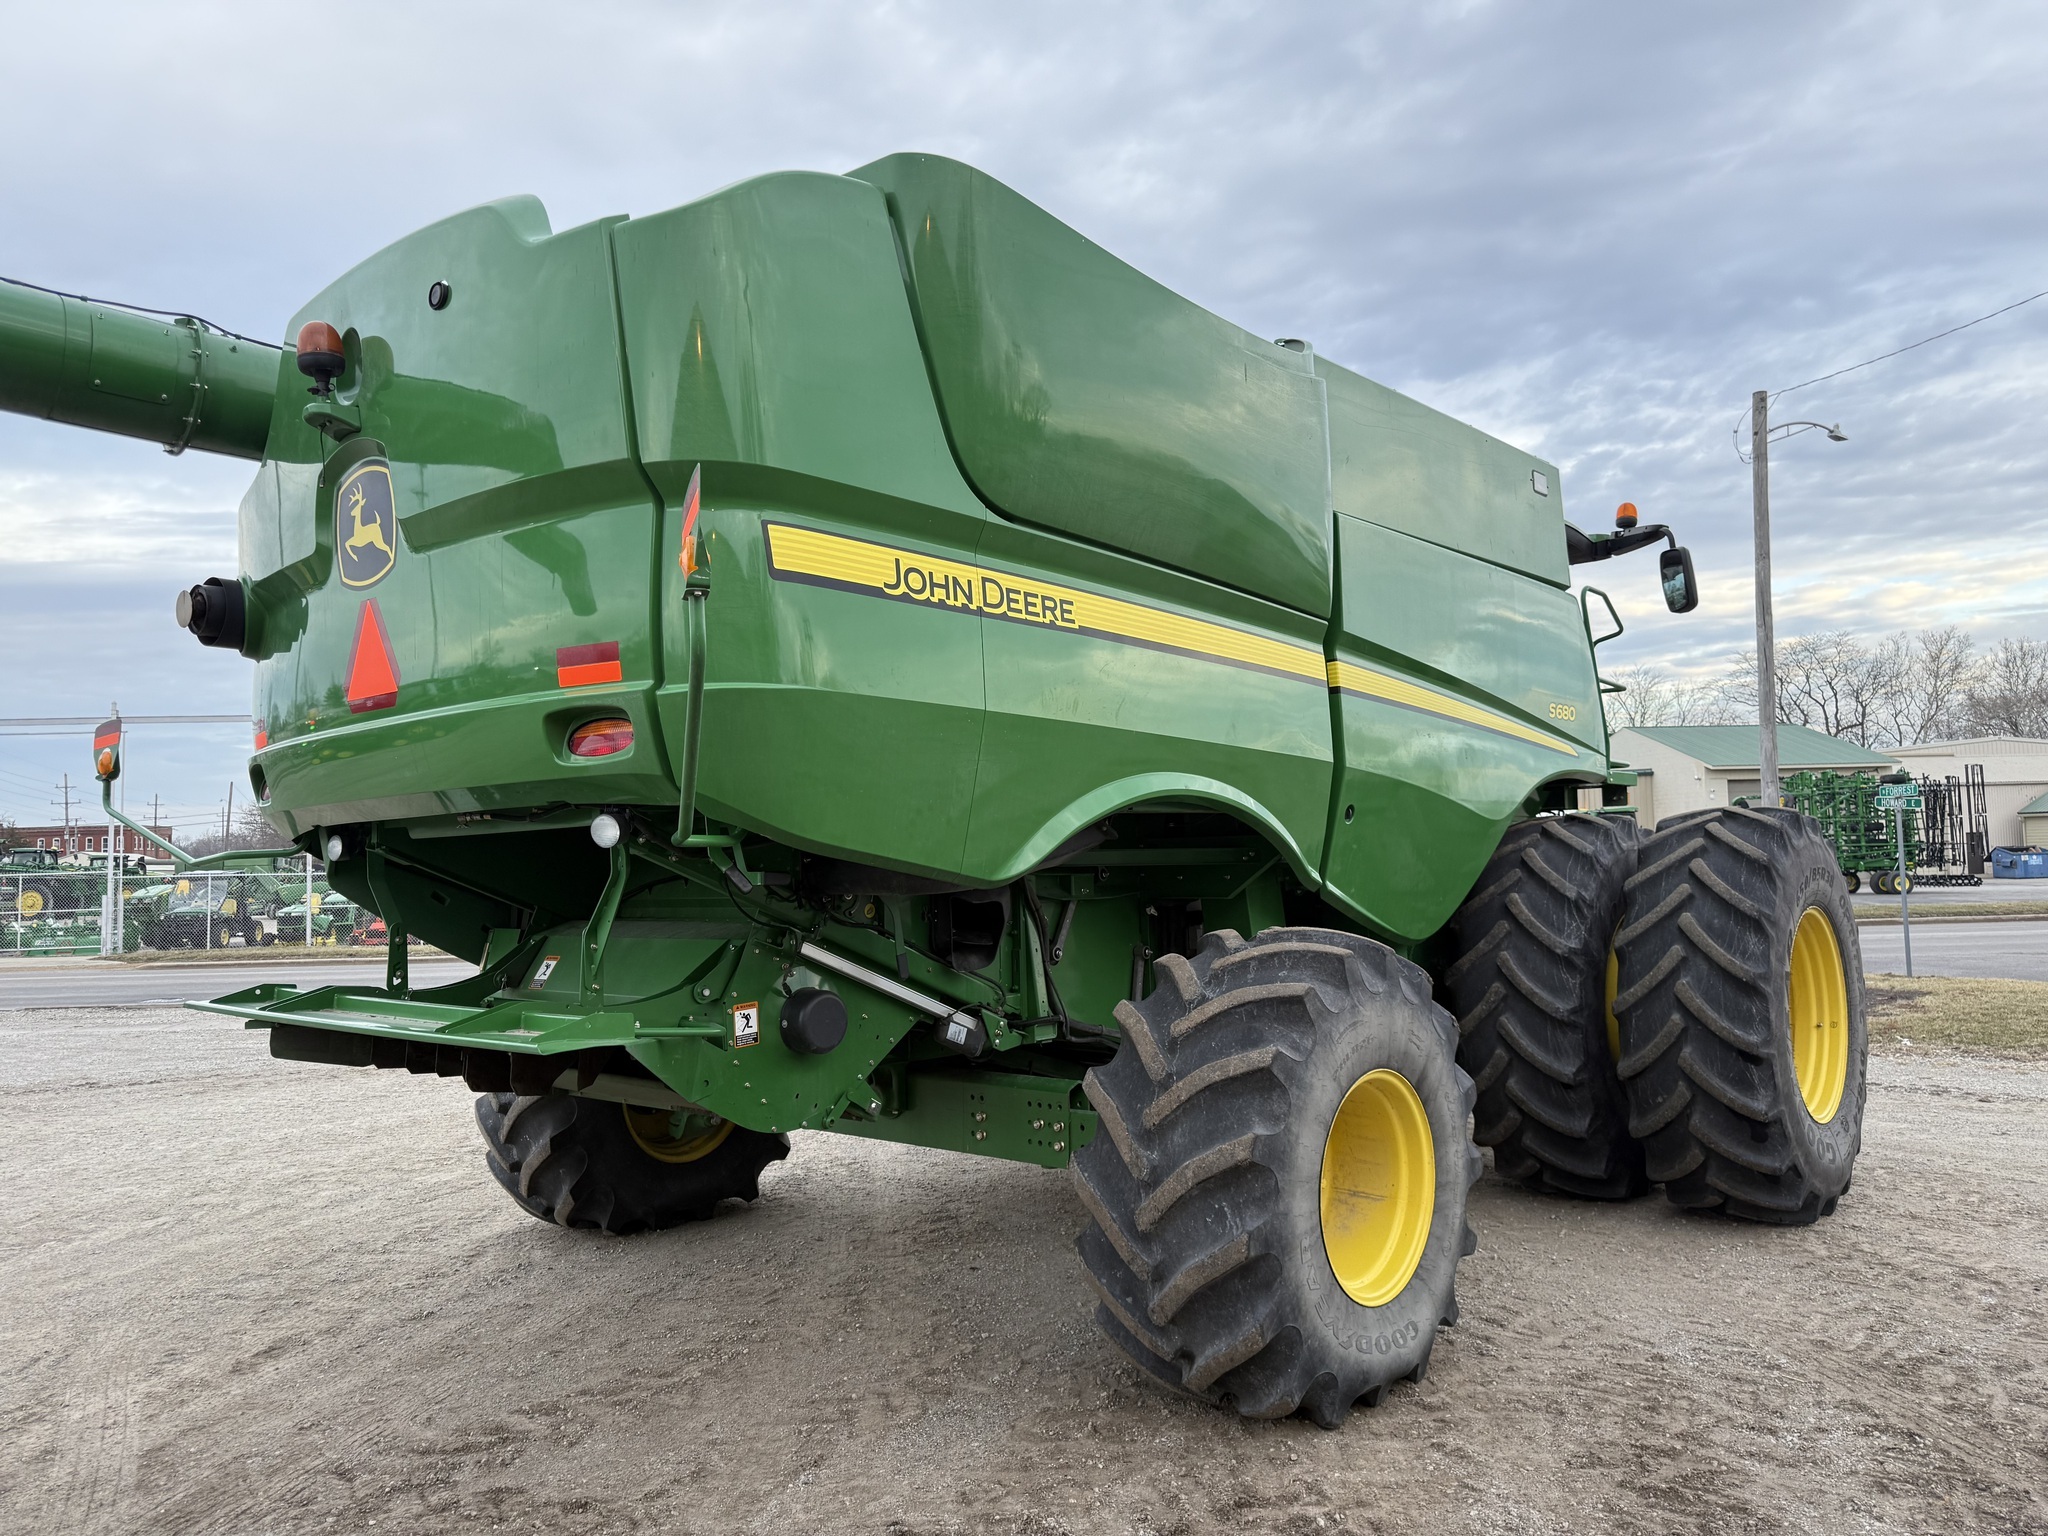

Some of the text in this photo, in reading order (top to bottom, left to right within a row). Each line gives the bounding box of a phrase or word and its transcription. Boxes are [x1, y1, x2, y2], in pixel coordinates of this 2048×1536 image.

[883, 557, 1077, 626] JOHN DEERE
[1549, 702, 1576, 721] S680
[1885, 785, 1915, 796] FORREST
[1881, 798, 1907, 807] HOWARD
[1301, 1236, 1419, 1355] GOODYEAR
